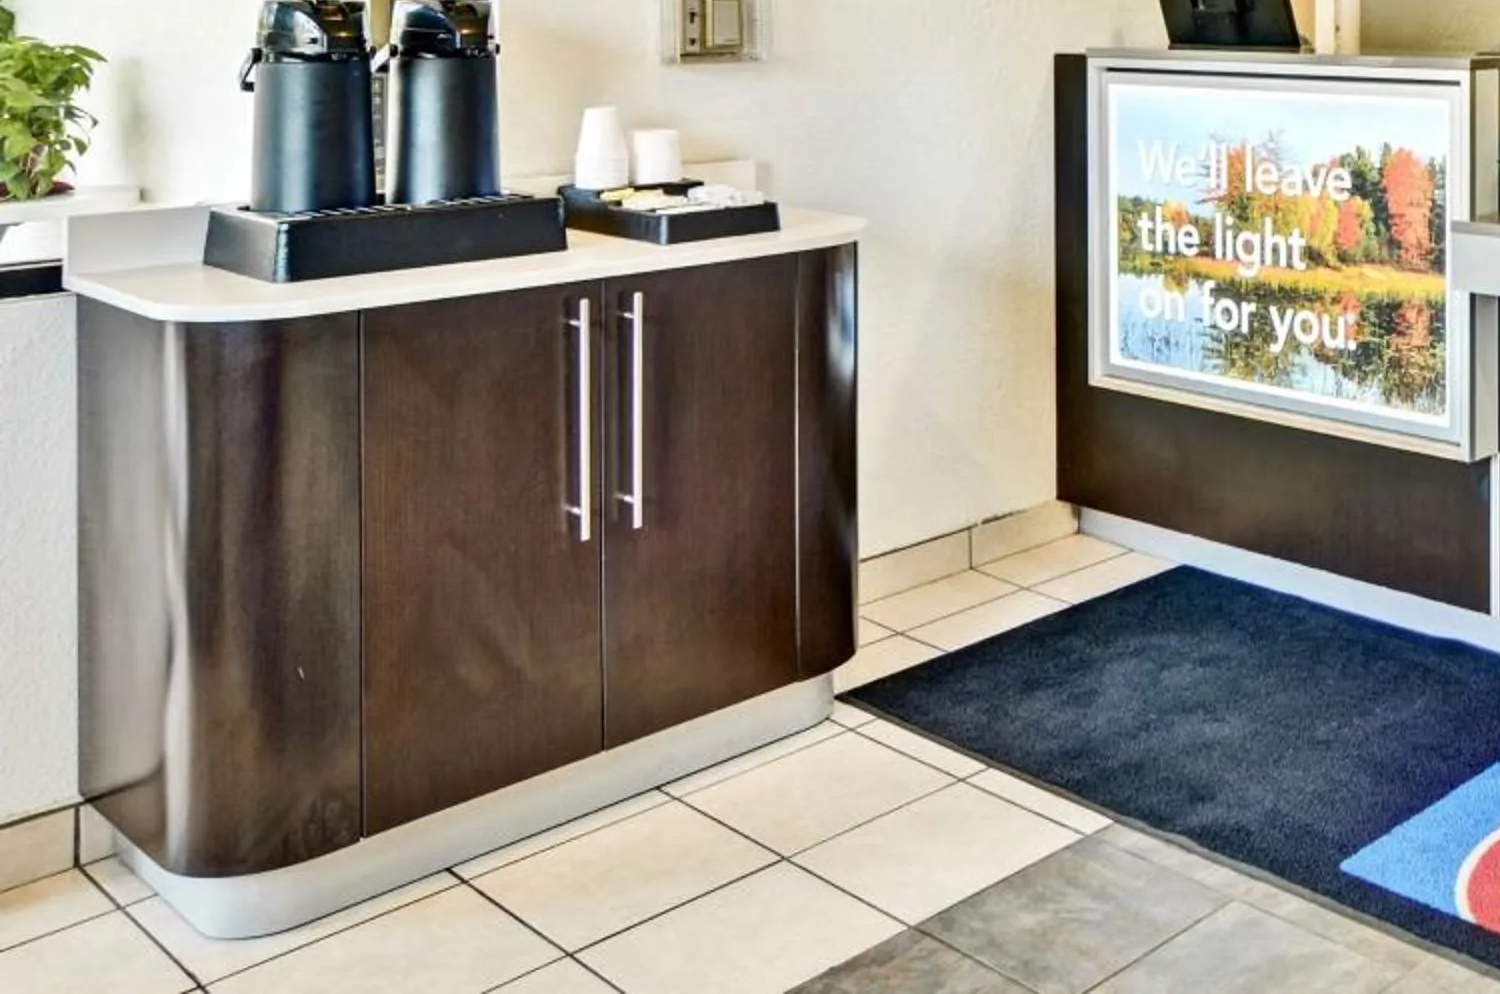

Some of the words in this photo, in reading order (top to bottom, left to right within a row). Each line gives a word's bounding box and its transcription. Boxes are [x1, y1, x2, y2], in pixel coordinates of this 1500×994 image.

[1138, 140, 1229, 194] We'll
[1244, 144, 1352, 200] leave
[1138, 206, 1200, 256] the
[1214, 211, 1306, 277] light
[1138, 284, 1185, 321] on
[1199, 282, 1257, 335] for
